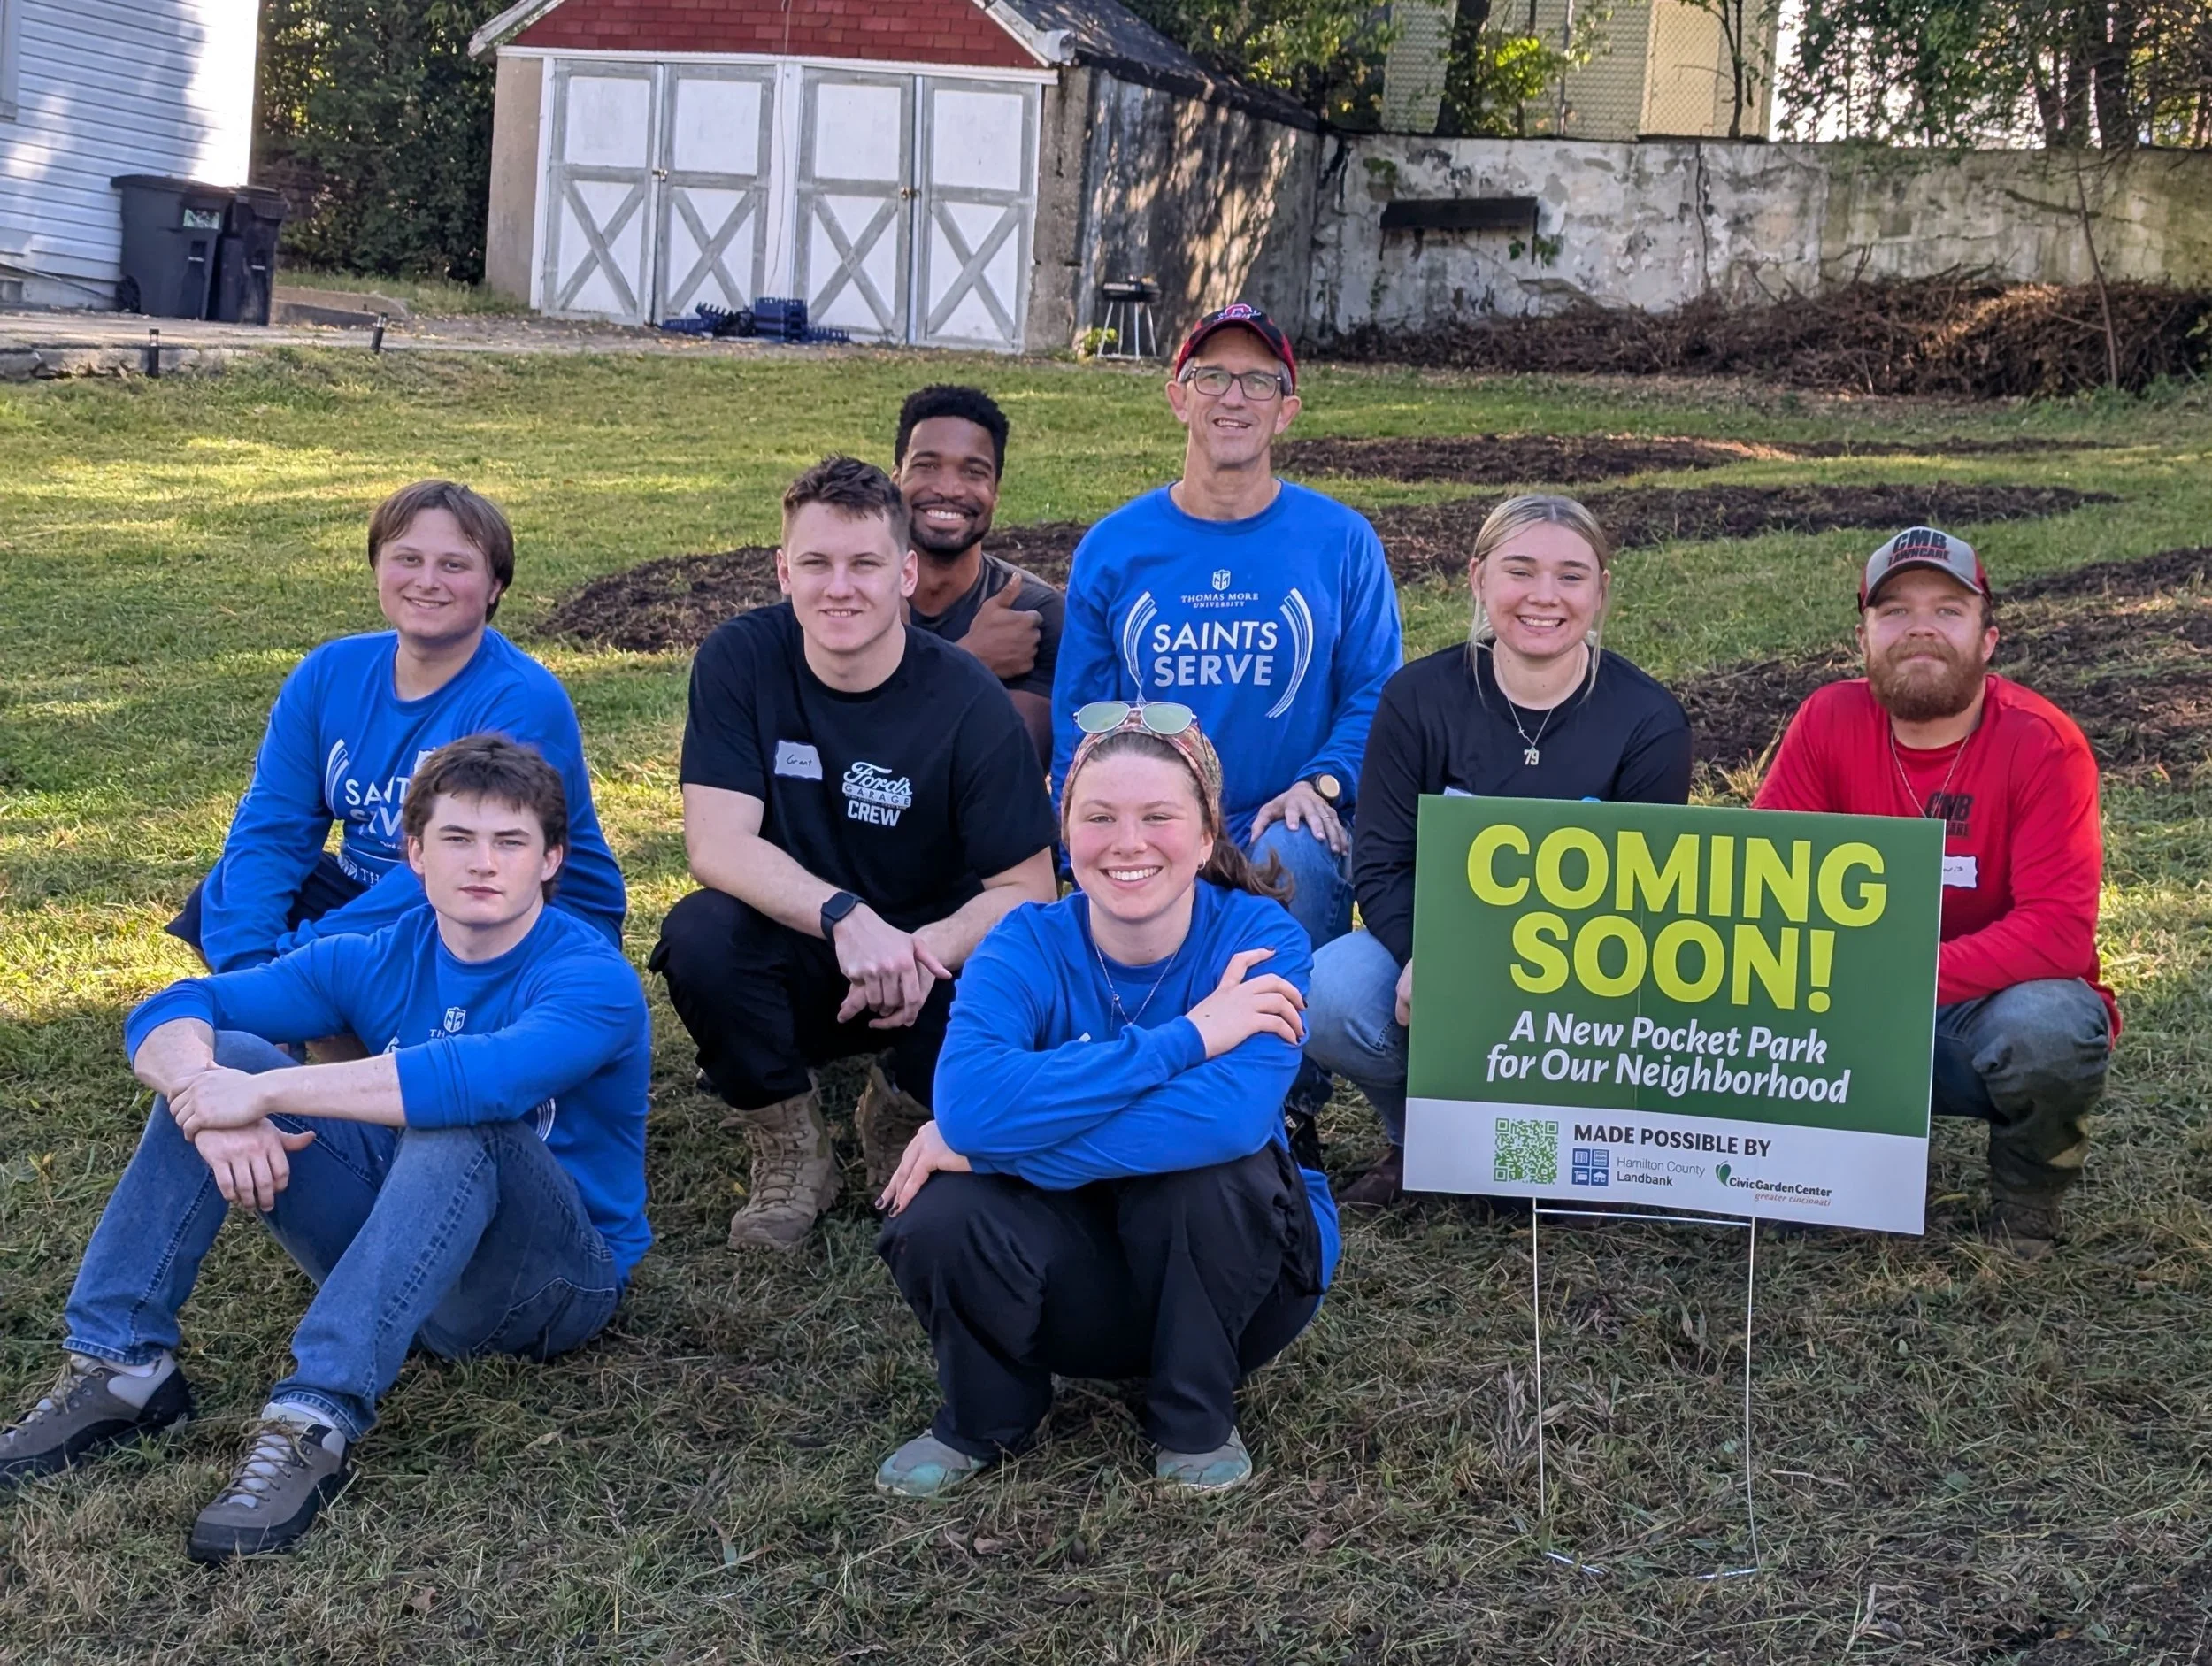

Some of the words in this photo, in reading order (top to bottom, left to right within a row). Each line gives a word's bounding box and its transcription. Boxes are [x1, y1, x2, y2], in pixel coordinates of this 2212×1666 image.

[1893, 529, 1947, 553] CMB
[1181, 593, 1225, 603] THOMAS
[1227, 592, 1259, 602] MORE
[1193, 600, 1246, 609] UNIVERSITY
[1152, 620, 1279, 653] SAINTS
[1153, 653, 1274, 687] SERVE
[843, 761, 913, 796] Ford's
[844, 783, 910, 806] GARAGE
[847, 799, 902, 827] CREW
[1466, 823, 1888, 928] COMING
[1509, 911, 1836, 1014] SOON!
[1509, 1010, 1536, 1043] A
[1543, 1011, 1624, 1048] New
[1630, 1017, 1742, 1057] Pocket
[1747, 1025, 1828, 1064] Park
[1486, 1044, 1536, 1082] for
[1540, 1048, 1609, 1084] Our
[1615, 1052, 1851, 1104] Neighborhood
[1573, 1124, 1635, 1144] MADE
[1640, 1127, 1739, 1155] POSSIBLE
[1744, 1138, 1772, 1157] BY
[1617, 1156, 1664, 1171] Hamilton
[1667, 1160, 1706, 1178] County
[1617, 1171, 1673, 1186] Landbank
[1754, 1192, 1787, 1202] greater
[1788, 1195, 1832, 1207] cincinnati
